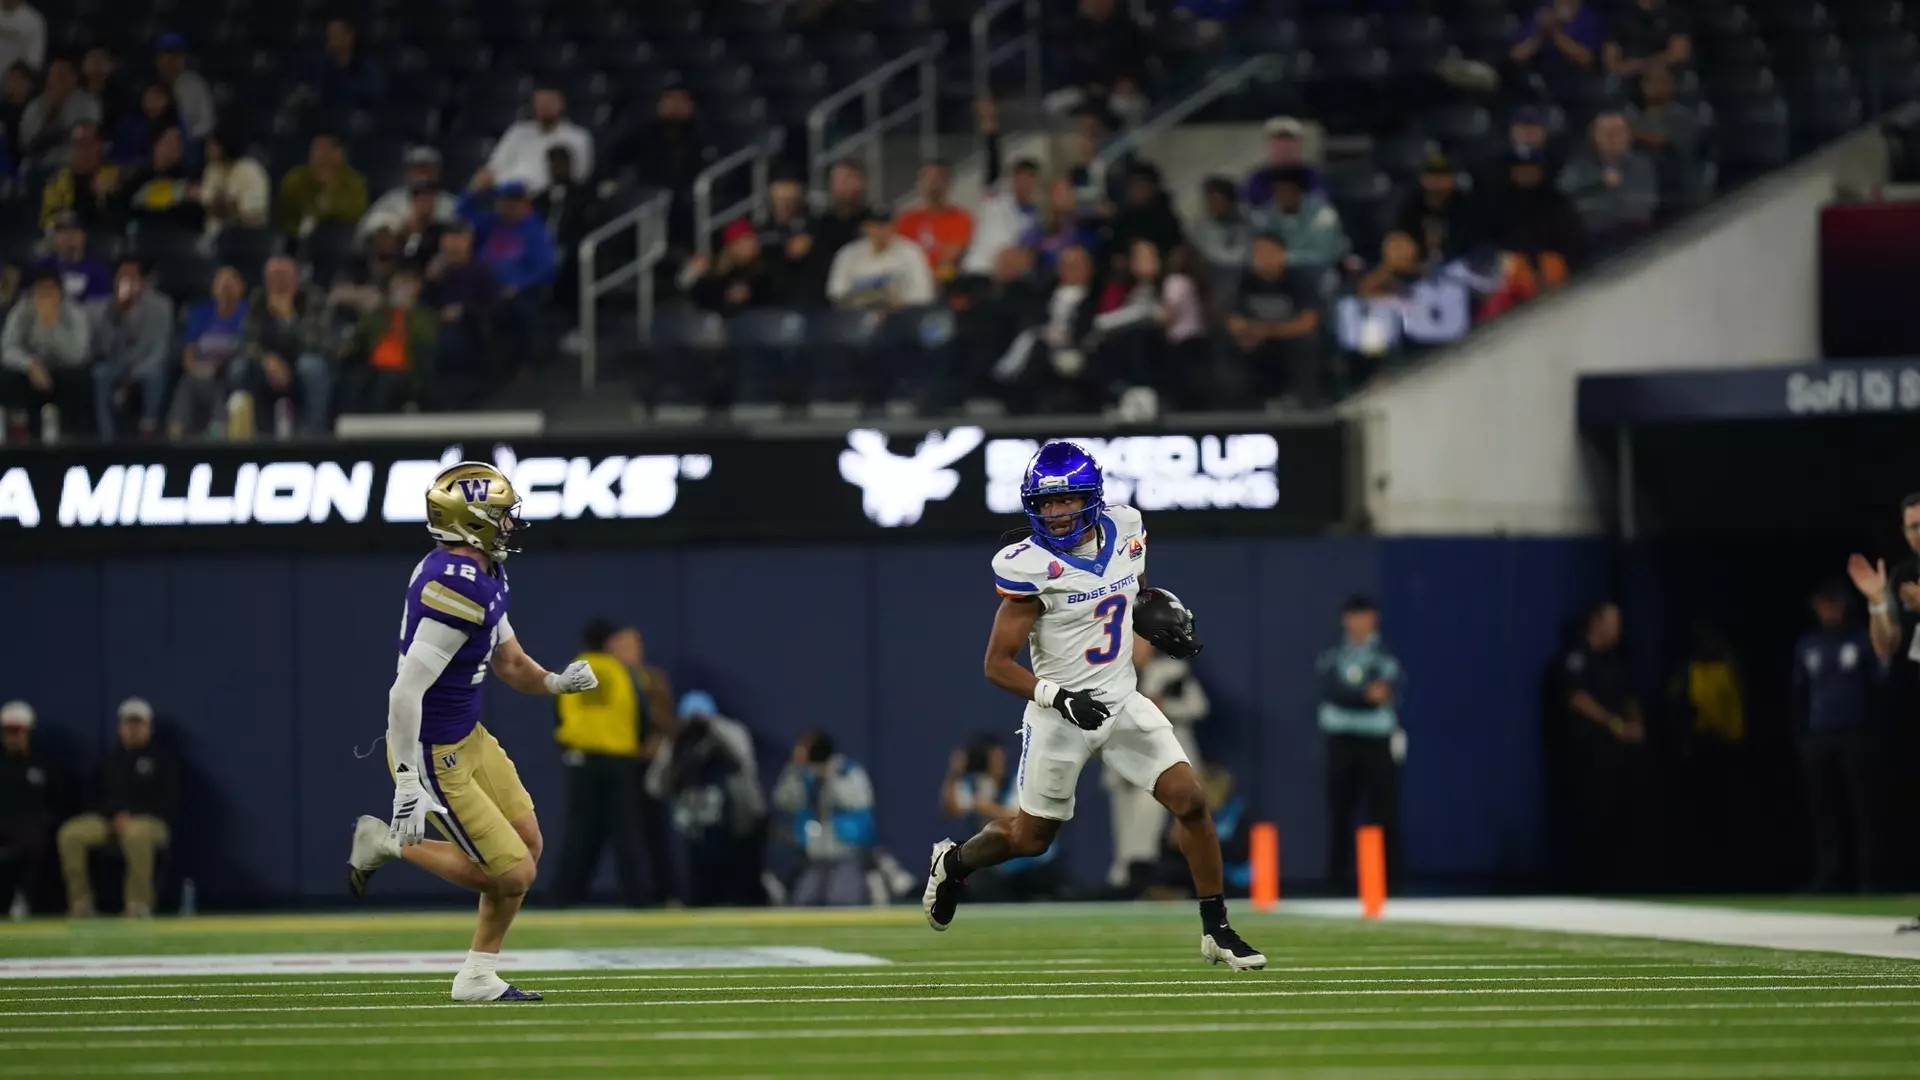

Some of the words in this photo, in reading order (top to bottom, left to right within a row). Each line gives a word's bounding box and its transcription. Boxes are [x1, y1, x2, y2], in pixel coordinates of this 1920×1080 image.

[1201, 434, 1280, 478] UP
[0, 465, 41, 528] A
[58, 460, 374, 527] MILLION
[382, 450, 680, 522] BCKS
[456, 477, 492, 504] W
[1004, 543, 1031, 560] 3
[1129, 536, 1143, 554] LA
[444, 563, 477, 582] 12
[1067, 586, 1107, 605] BOISE
[1109, 573, 1136, 593] STATE
[1085, 593, 1129, 666] 3
[441, 751, 456, 769] W
